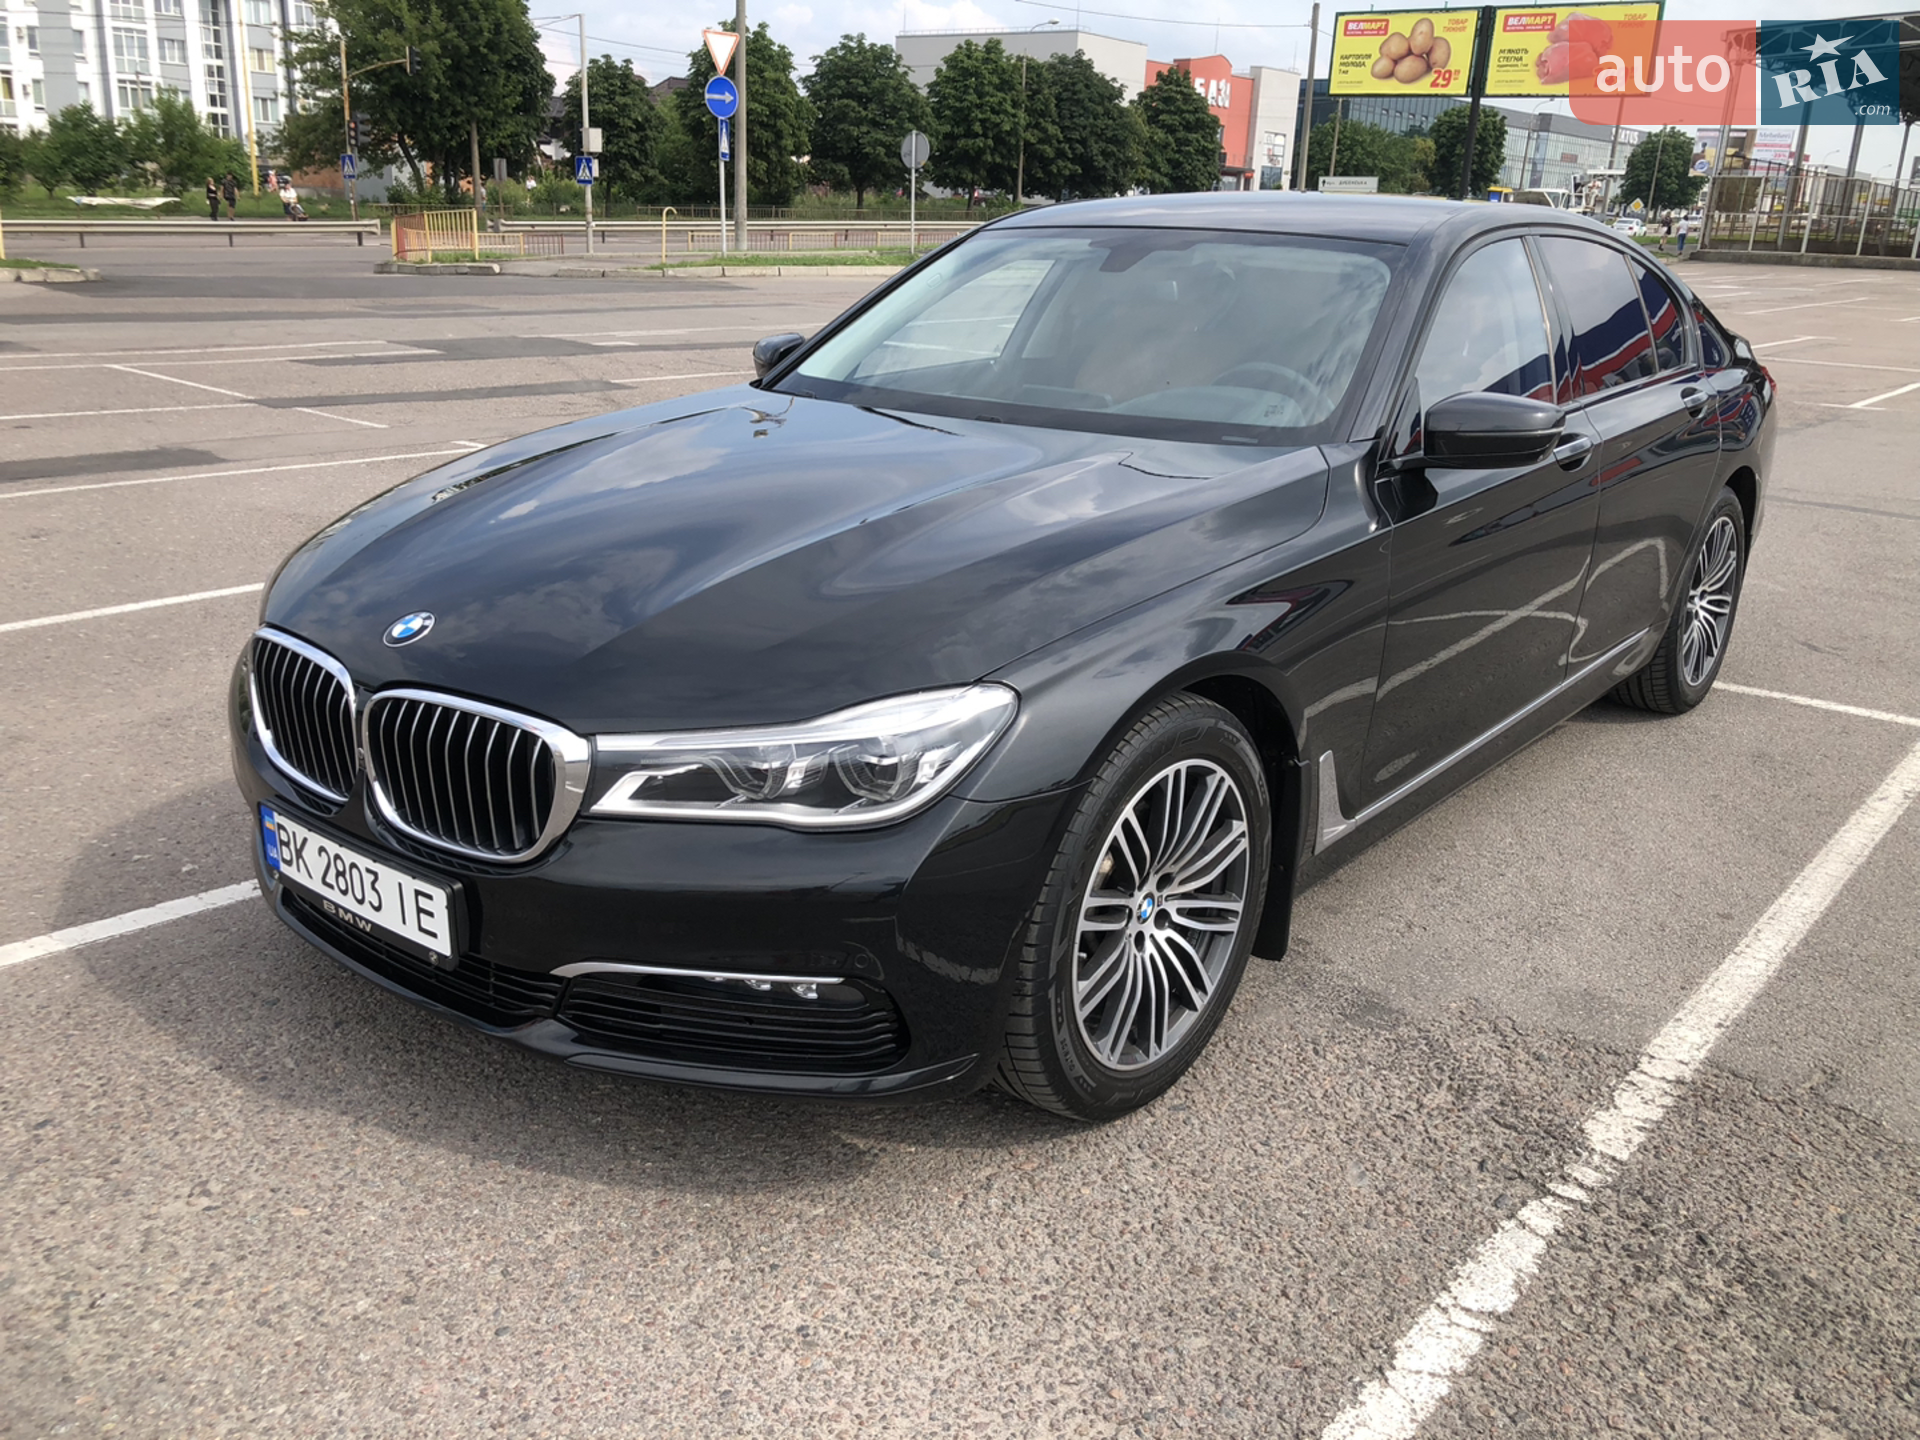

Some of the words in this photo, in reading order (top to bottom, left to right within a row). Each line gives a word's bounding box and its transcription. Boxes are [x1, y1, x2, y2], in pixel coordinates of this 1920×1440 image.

[1347, 20, 1388, 31] ВЕЛМАРТ
[1507, 15, 1554, 26] ВЕЛМАРТ
[1340, 53, 1373, 61] КАРТОПЛЯ
[1497, 55, 1523, 63] СТЕГНА
[1429, 69, 1453, 89] 29
[276, 821, 314, 881] BK
[317, 845, 384, 913] 2803
[398, 881, 439, 940] IE
[322, 899, 372, 933] BMW
